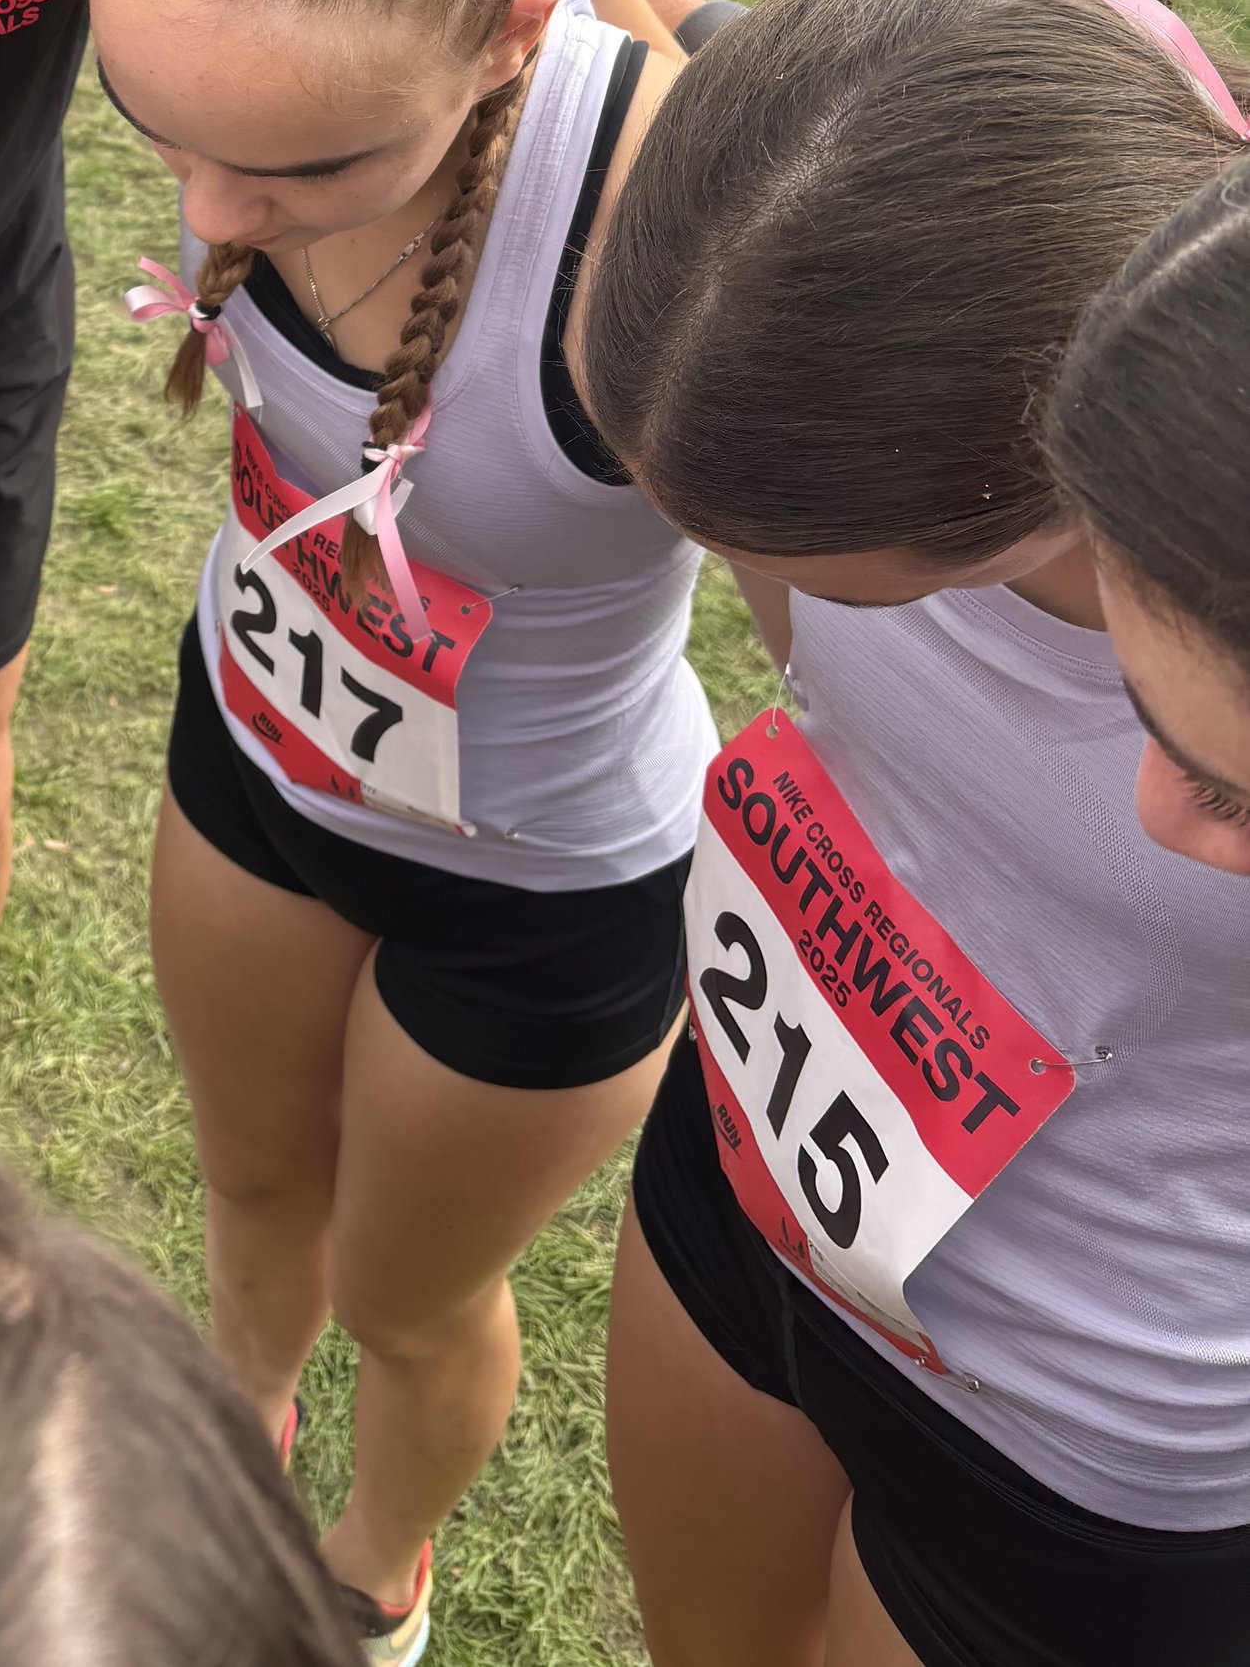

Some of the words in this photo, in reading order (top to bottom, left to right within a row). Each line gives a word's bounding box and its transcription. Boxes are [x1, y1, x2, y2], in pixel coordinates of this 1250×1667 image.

[230, 563, 403, 764] 217
[717, 757, 1021, 1134] SOUTHWEST
[772, 771, 814, 824] NIKE
[805, 822, 866, 904] CROSS
[864, 900, 991, 1050] REGIONALS
[798, 928, 852, 1007] 2025
[699, 911, 890, 1249] 215
[716, 1103, 743, 1150] RUN
